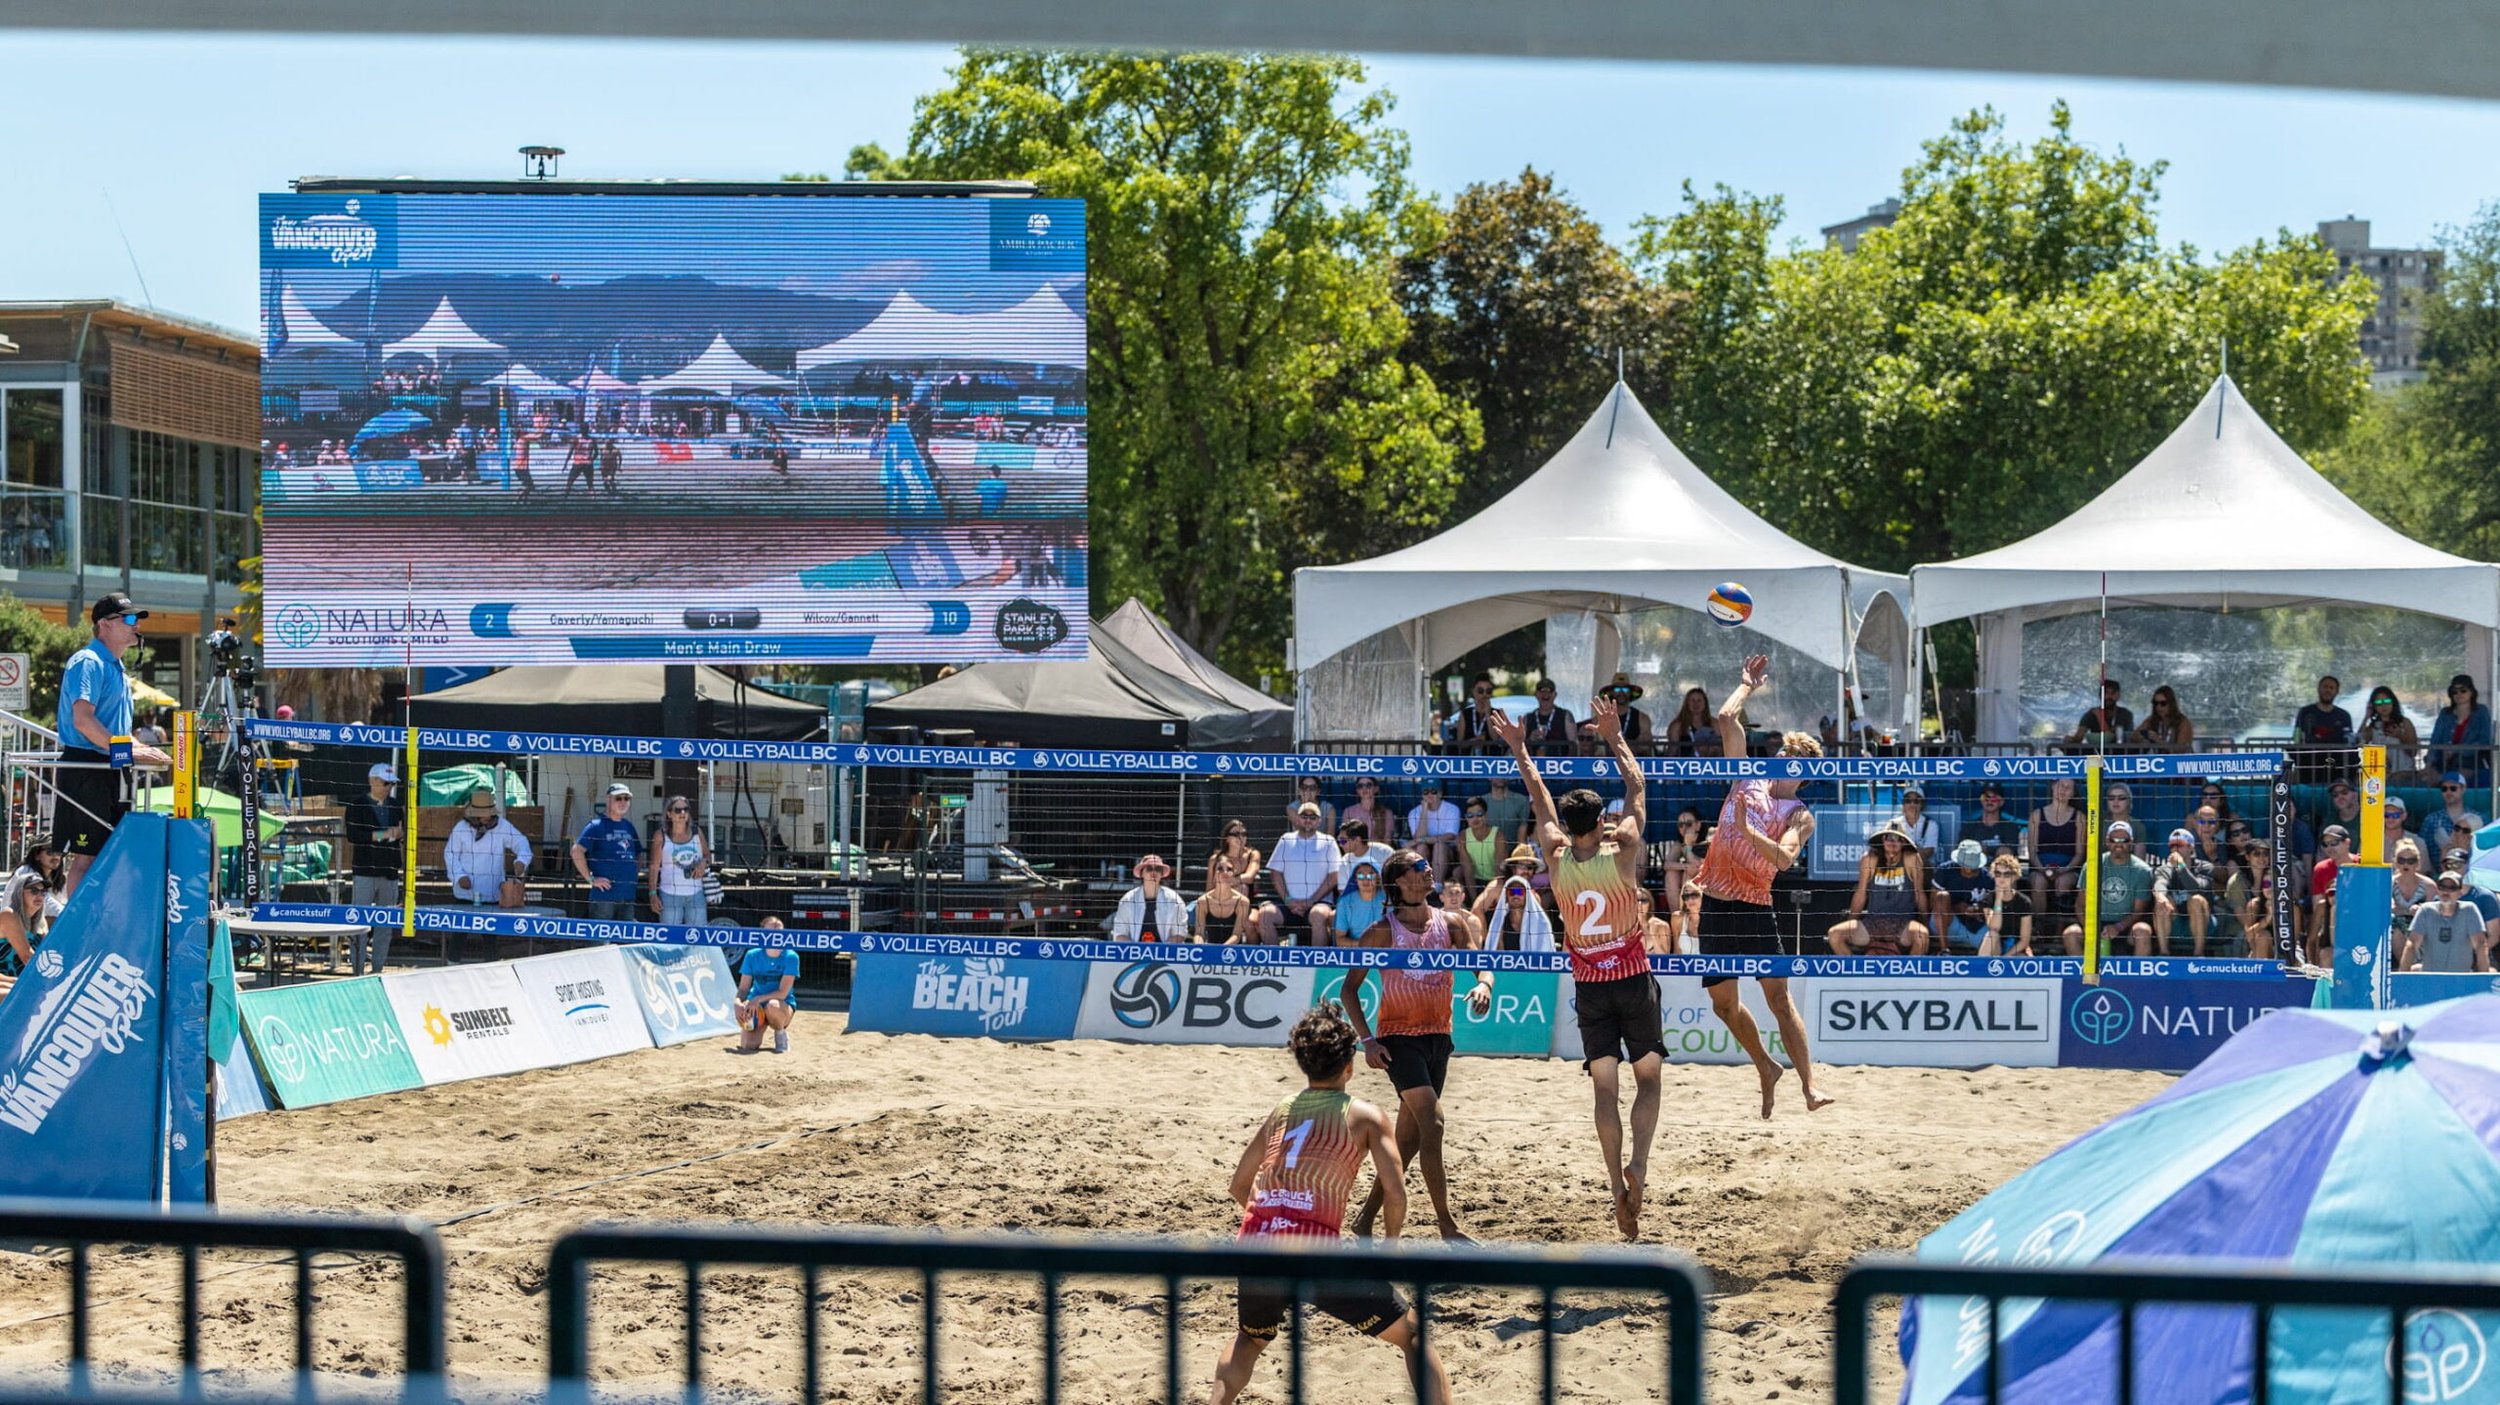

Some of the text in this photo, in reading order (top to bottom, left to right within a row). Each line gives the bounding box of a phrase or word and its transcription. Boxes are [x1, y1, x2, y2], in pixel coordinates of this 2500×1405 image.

[273, 214, 296, 230] The
[272, 227, 377, 249] VANCOUVER
[327, 609, 449, 632] NATURA
[484, 614, 494, 628] 2
[942, 611, 958, 625] 10
[1003, 612, 1057, 625] STANLEY
[1003, 624, 1035, 635] PARK
[328, 636, 398, 646] SOLUTIONS
[664, 640, 781, 655] Men's Main Draw
[254, 723, 331, 741] WWW.VOLLEYBALLBC.ORG
[526, 736, 662, 756] VOLLEYBALLBC
[699, 743, 837, 761] VOLLEYBALLBC
[874, 748, 1016, 765] VOLLEYBALLBC
[1053, 754, 1198, 770] VOLLEYBALLBC
[1236, 756, 1384, 773] VOLLEYBALLBC
[1807, 759, 1965, 775] VOLLEYBALLBC
[2005, 757, 2165, 775] VOLLEYALLBC
[2176, 758, 2272, 774] WWW.VOLLEYBALLBC.ORG
[177, 782, 187, 795] by
[1575, 889, 1612, 936] 2
[533, 919, 669, 942] VOLLEYBALLBC
[704, 930, 843, 950] VOLLEYBALLBC
[880, 937, 1022, 956] VOLLEYBALLBC
[1058, 943, 1203, 963] VOLLEYBALLBC
[1241, 948, 1389, 966] VOLLEYBALLBC
[1813, 959, 1970, 975] VOLLEYBALLBC
[2009, 960, 2169, 976] VOLLEYALLBC
[664, 952, 711, 972] VOLLEYBALL
[918, 959, 950, 977] The
[1191, 963, 1289, 978] VOLLEYBALL
[667, 967, 730, 1025] BC
[912, 974, 1030, 1012] BEACH
[1183, 978, 1288, 1029] BC
[450, 1006, 512, 1033] SUNBELT
[978, 1005, 1028, 1034] Tour
[1679, 1007, 1707, 1025] OF
[1829, 1000, 2037, 1031] SKYBALL
[0, 953, 144, 1135] VANCOUVER
[303, 1020, 405, 1067] NATURA
[467, 1028, 510, 1040] RENTALS
[1284, 1119, 1314, 1169] 1
